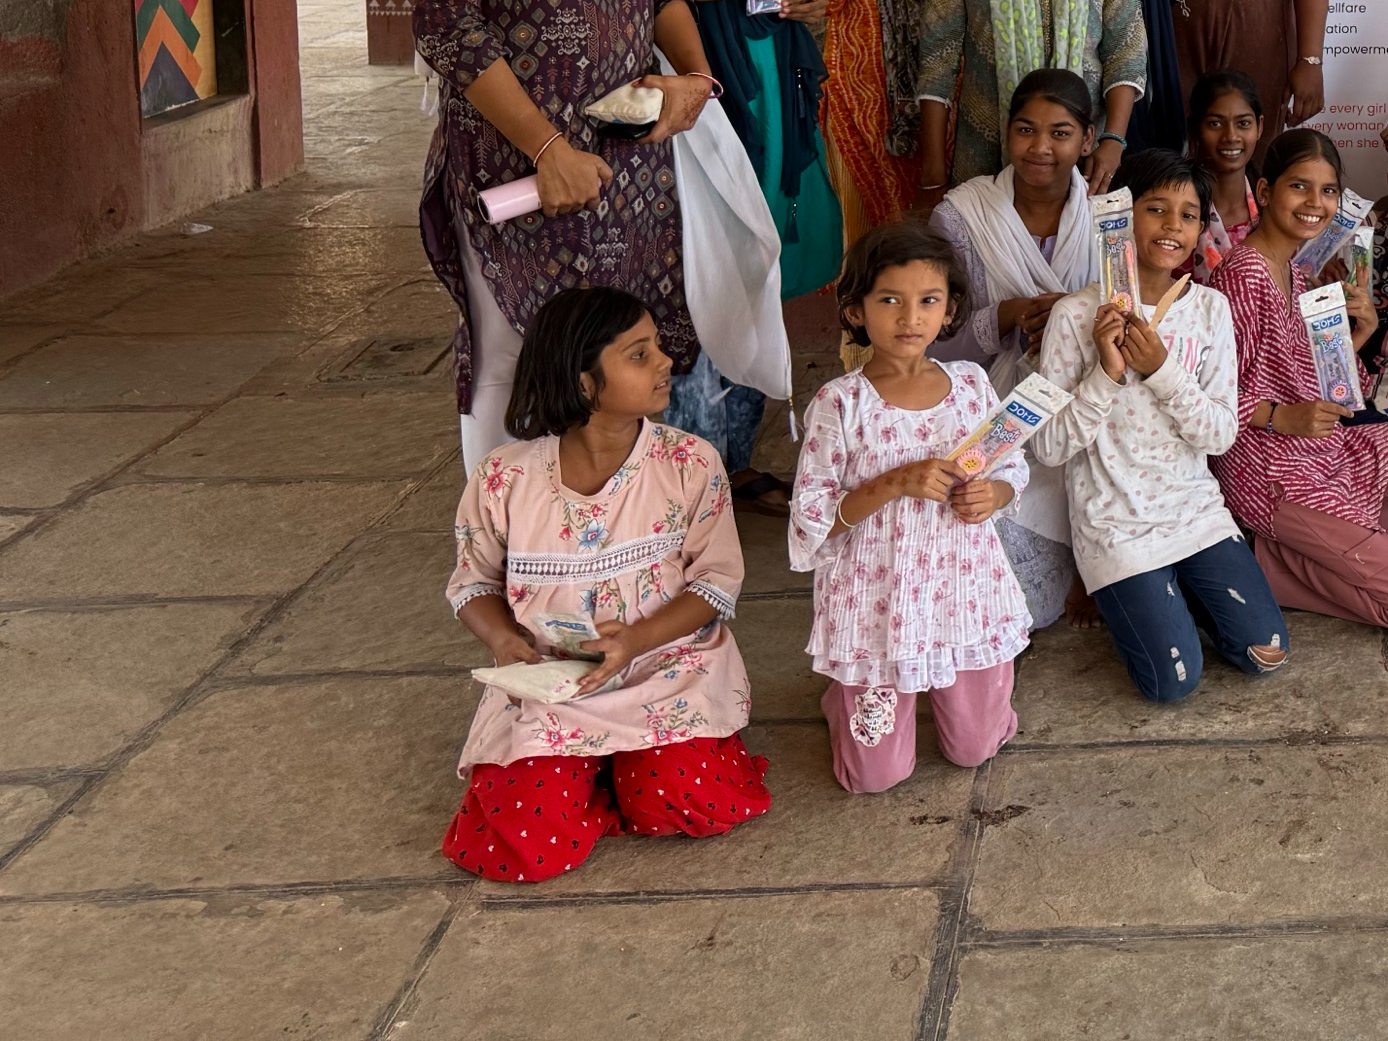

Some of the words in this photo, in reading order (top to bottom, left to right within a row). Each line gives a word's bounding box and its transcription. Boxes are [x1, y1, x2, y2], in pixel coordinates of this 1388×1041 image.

[1328, 2, 1367, 14] ellfare
[1325, 23, 1358, 34] ation
[1330, 105, 1364, 117] every
[1367, 103, 1387, 117] girl
[1337, 122, 1384, 131] woman
[1357, 138, 1379, 148] she
[1313, 314, 1341, 330] DOMS
[1008, 402, 1041, 424] DOMS
[991, 423, 1022, 443] Best
